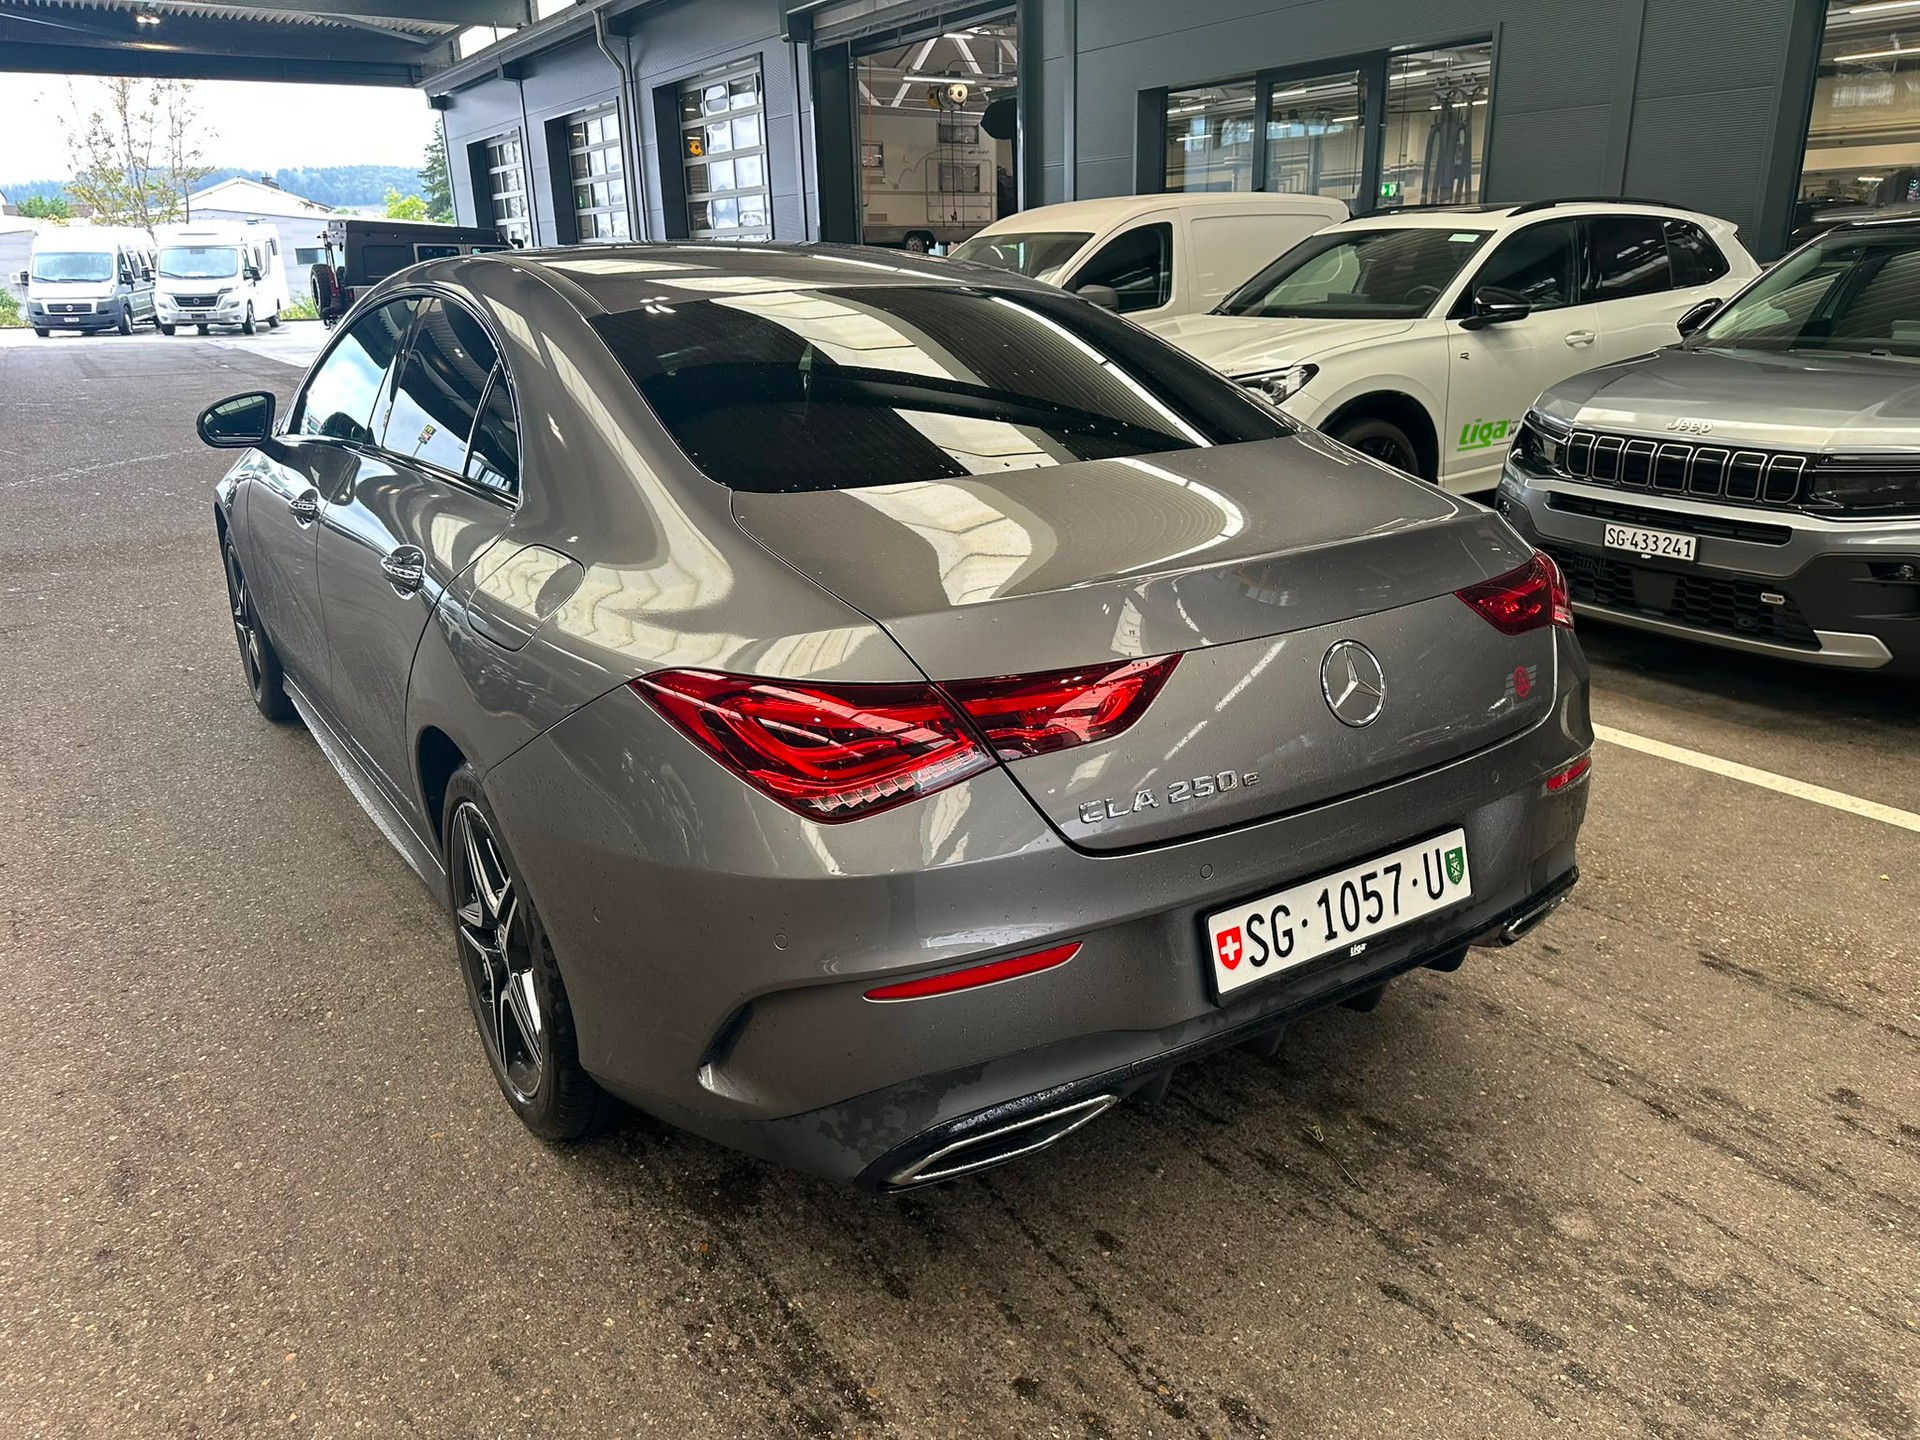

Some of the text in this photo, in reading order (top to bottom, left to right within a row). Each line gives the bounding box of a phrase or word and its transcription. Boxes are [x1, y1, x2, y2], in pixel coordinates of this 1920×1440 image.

[1456, 418, 1508, 452] Liga
[1665, 417, 1713, 436] Jeep
[1079, 788, 1160, 823] CLA
